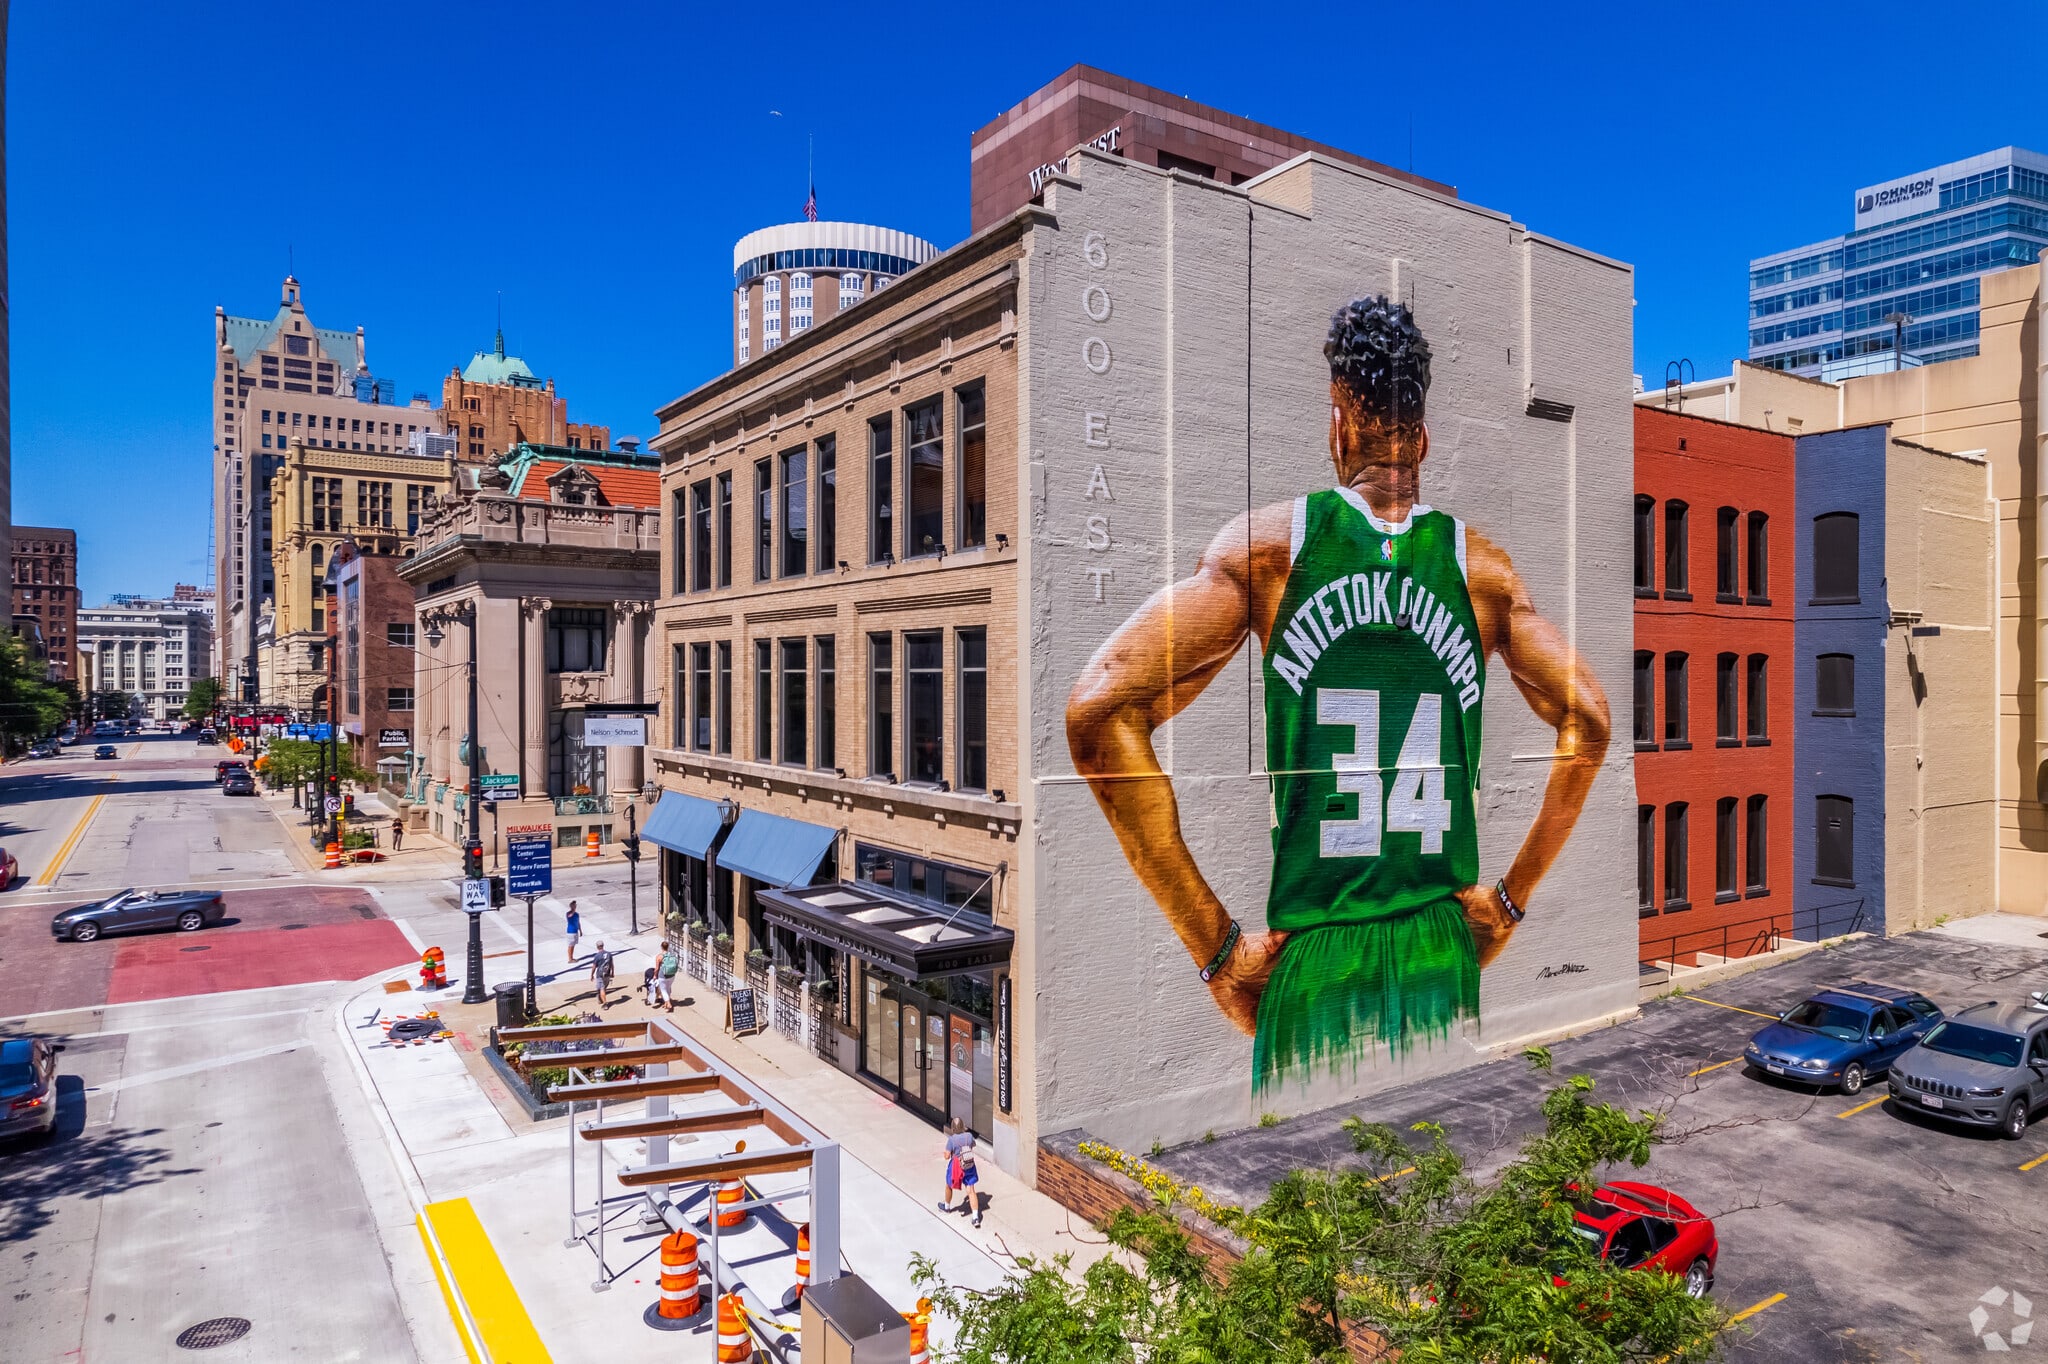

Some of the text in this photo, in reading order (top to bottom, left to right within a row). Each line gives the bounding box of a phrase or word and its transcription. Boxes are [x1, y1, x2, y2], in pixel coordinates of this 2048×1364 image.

[1875, 177, 1934, 206] JOHNSON
[1082, 230, 1115, 604] 600 EAST
[614, 728, 639, 736] Schmidt
[1316, 687, 1452, 858] 34
[485, 777, 513, 785] Jackson
[506, 824, 552, 834] MILWAUKEE
[517, 843, 546, 851] Convention
[466, 882, 485, 891] ONE
[517, 880, 542, 888] RiverWalk
[466, 890, 485, 899] WAY
